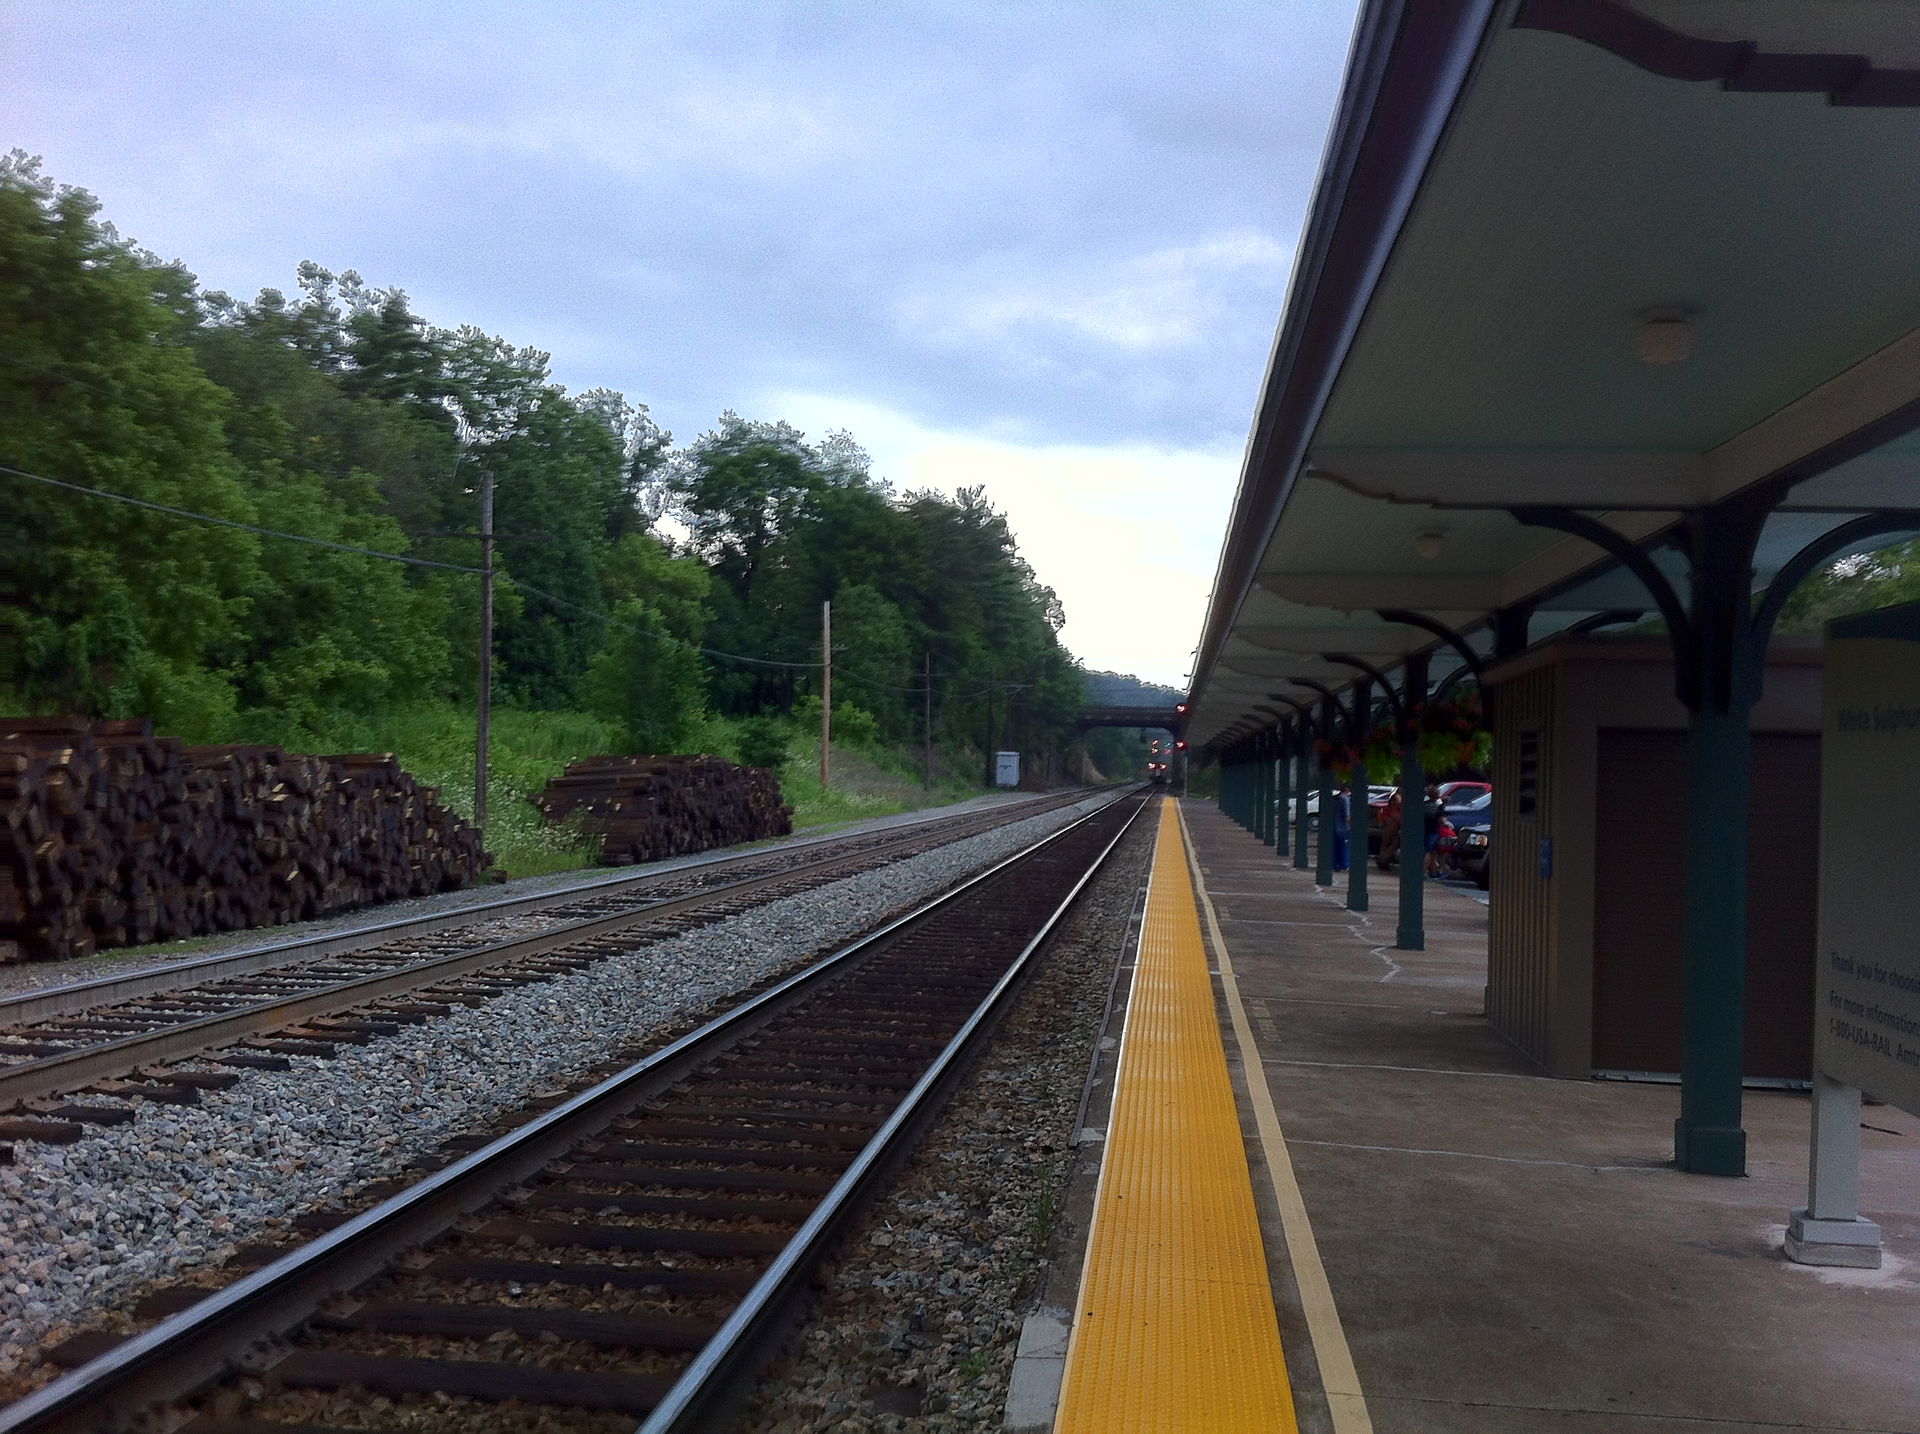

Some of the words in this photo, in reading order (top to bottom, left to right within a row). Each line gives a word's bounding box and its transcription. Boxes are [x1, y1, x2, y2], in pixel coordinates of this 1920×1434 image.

[1831, 952, 1853, 974] Thank
[1856, 961, 1872, 981] you
[1874, 962, 1886, 984] for
[1889, 967, 1920, 994] choosi
[1830, 989, 1842, 1009] For
[1844, 998, 1865, 1018] more
[1830, 1017, 1892, 1057] 1-800-USA-RAIL
